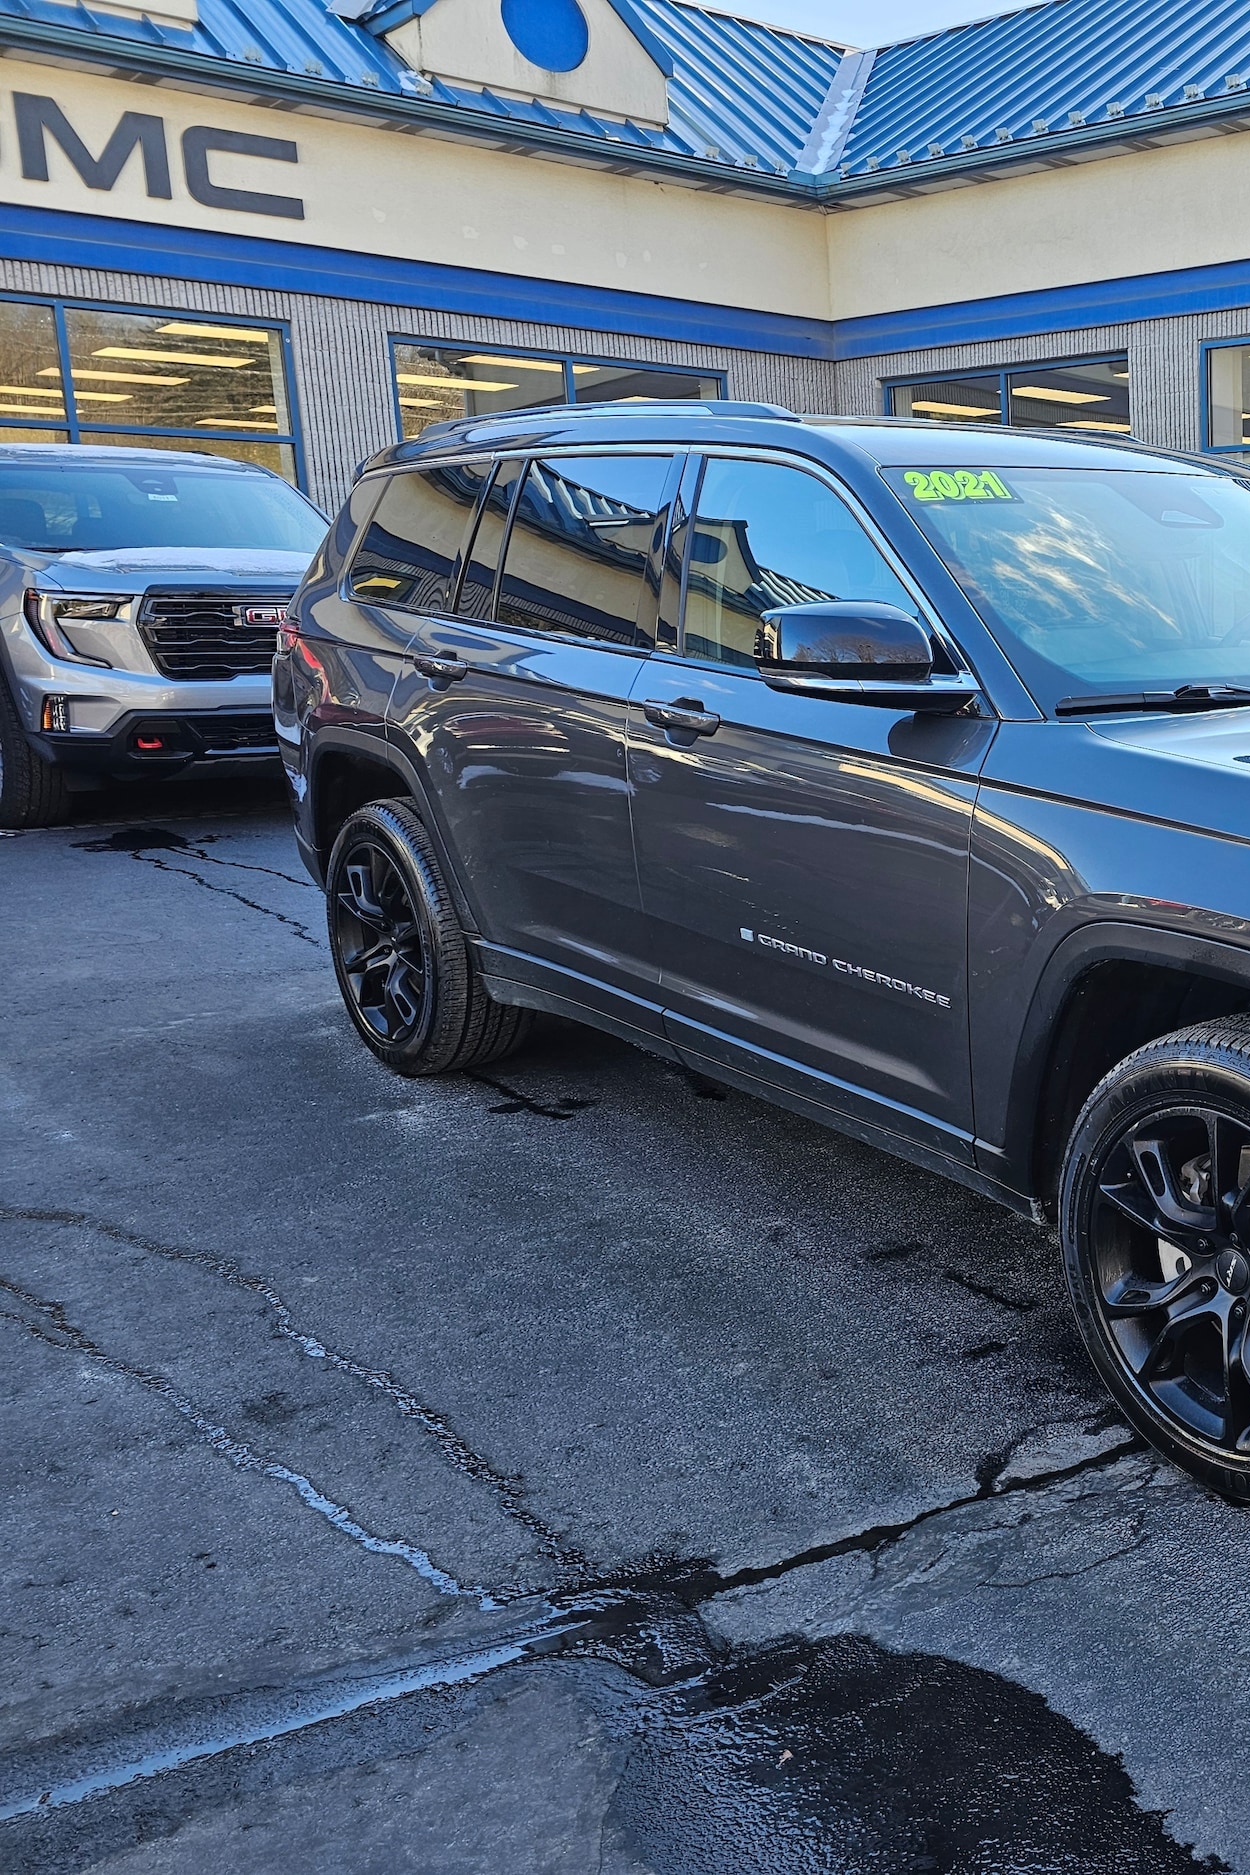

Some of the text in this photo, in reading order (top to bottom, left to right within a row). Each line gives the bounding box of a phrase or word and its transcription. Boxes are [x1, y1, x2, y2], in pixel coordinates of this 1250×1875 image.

[904, 470, 1013, 501] 2021
[757, 933, 952, 1009] GRAND CHEROKEE
